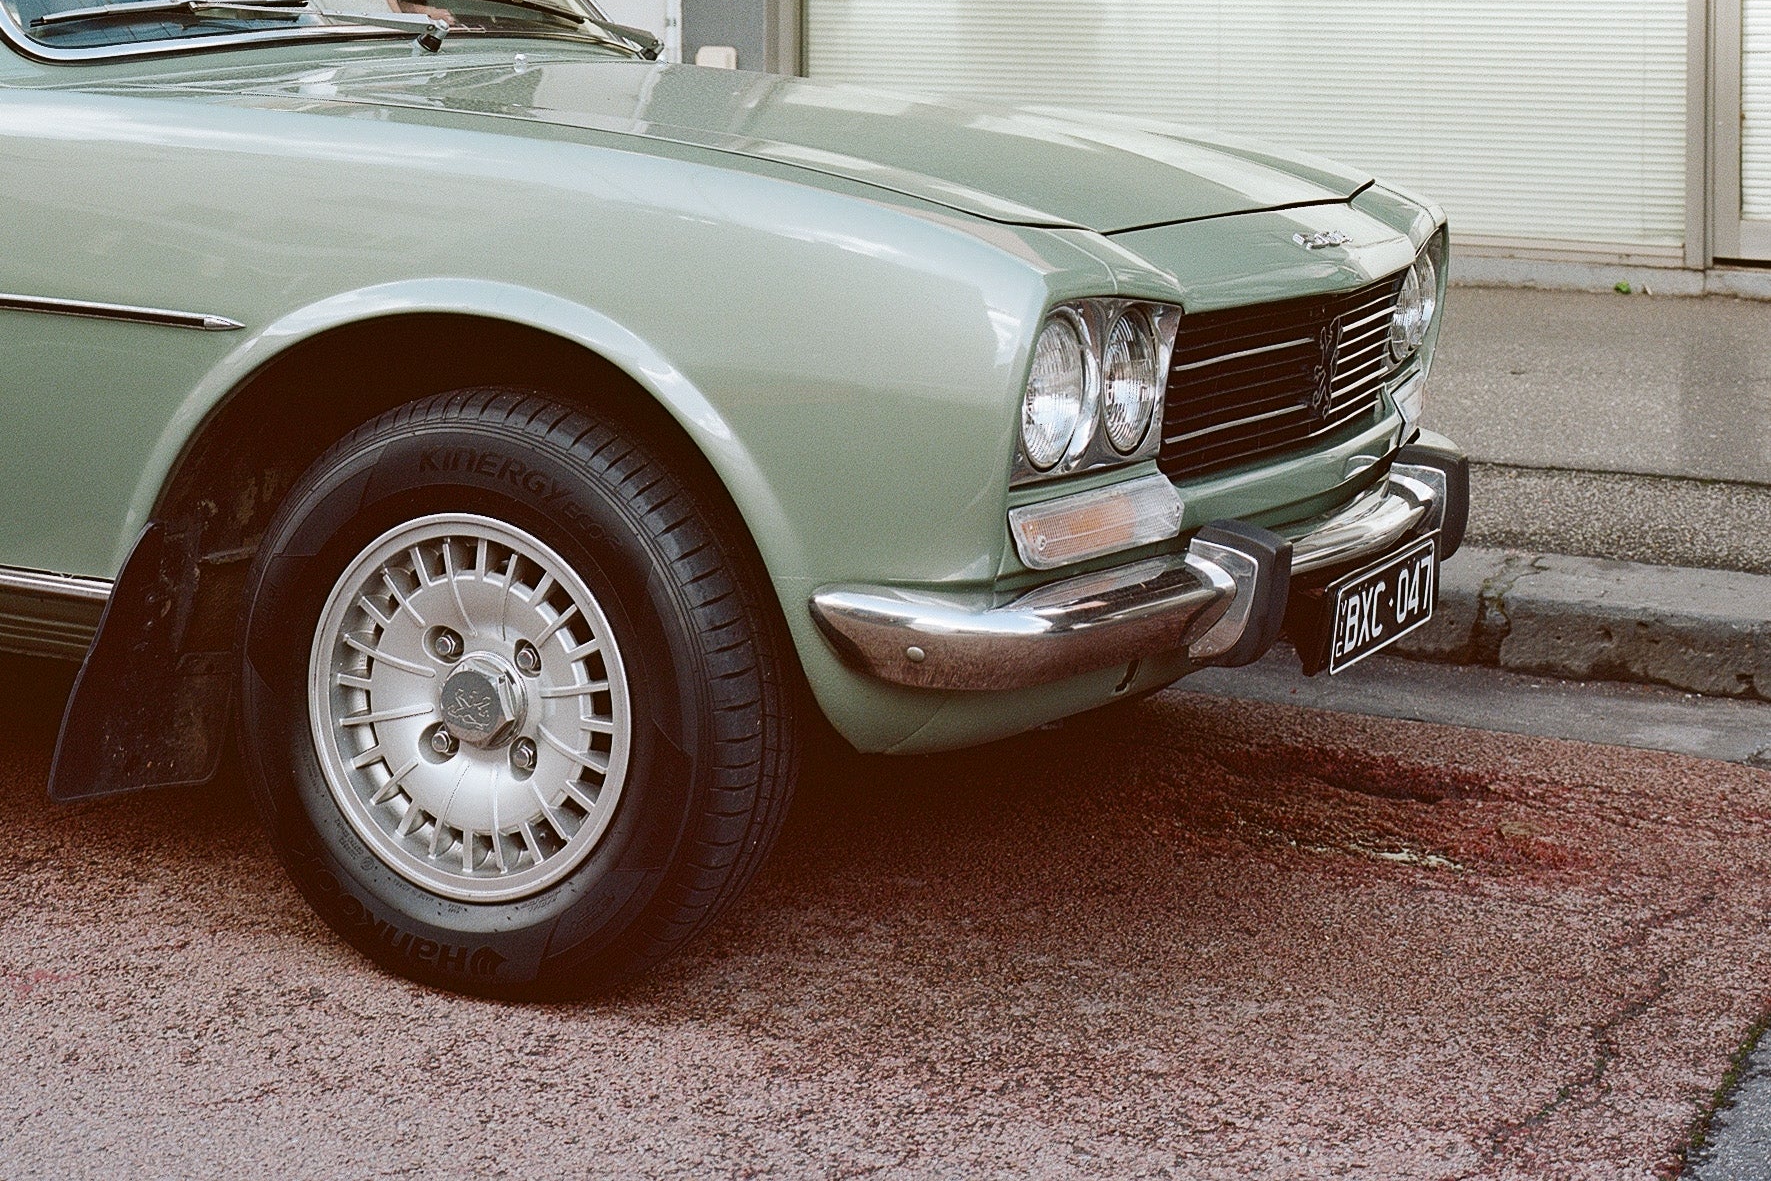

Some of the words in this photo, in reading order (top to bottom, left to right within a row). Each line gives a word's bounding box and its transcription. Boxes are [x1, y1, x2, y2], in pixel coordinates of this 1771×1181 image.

[418, 446, 574, 503] KINERGY
[1335, 599, 1348, 658] VIC
[1343, 581, 1386, 655] BXC
[1396, 554, 1432, 624] 047
